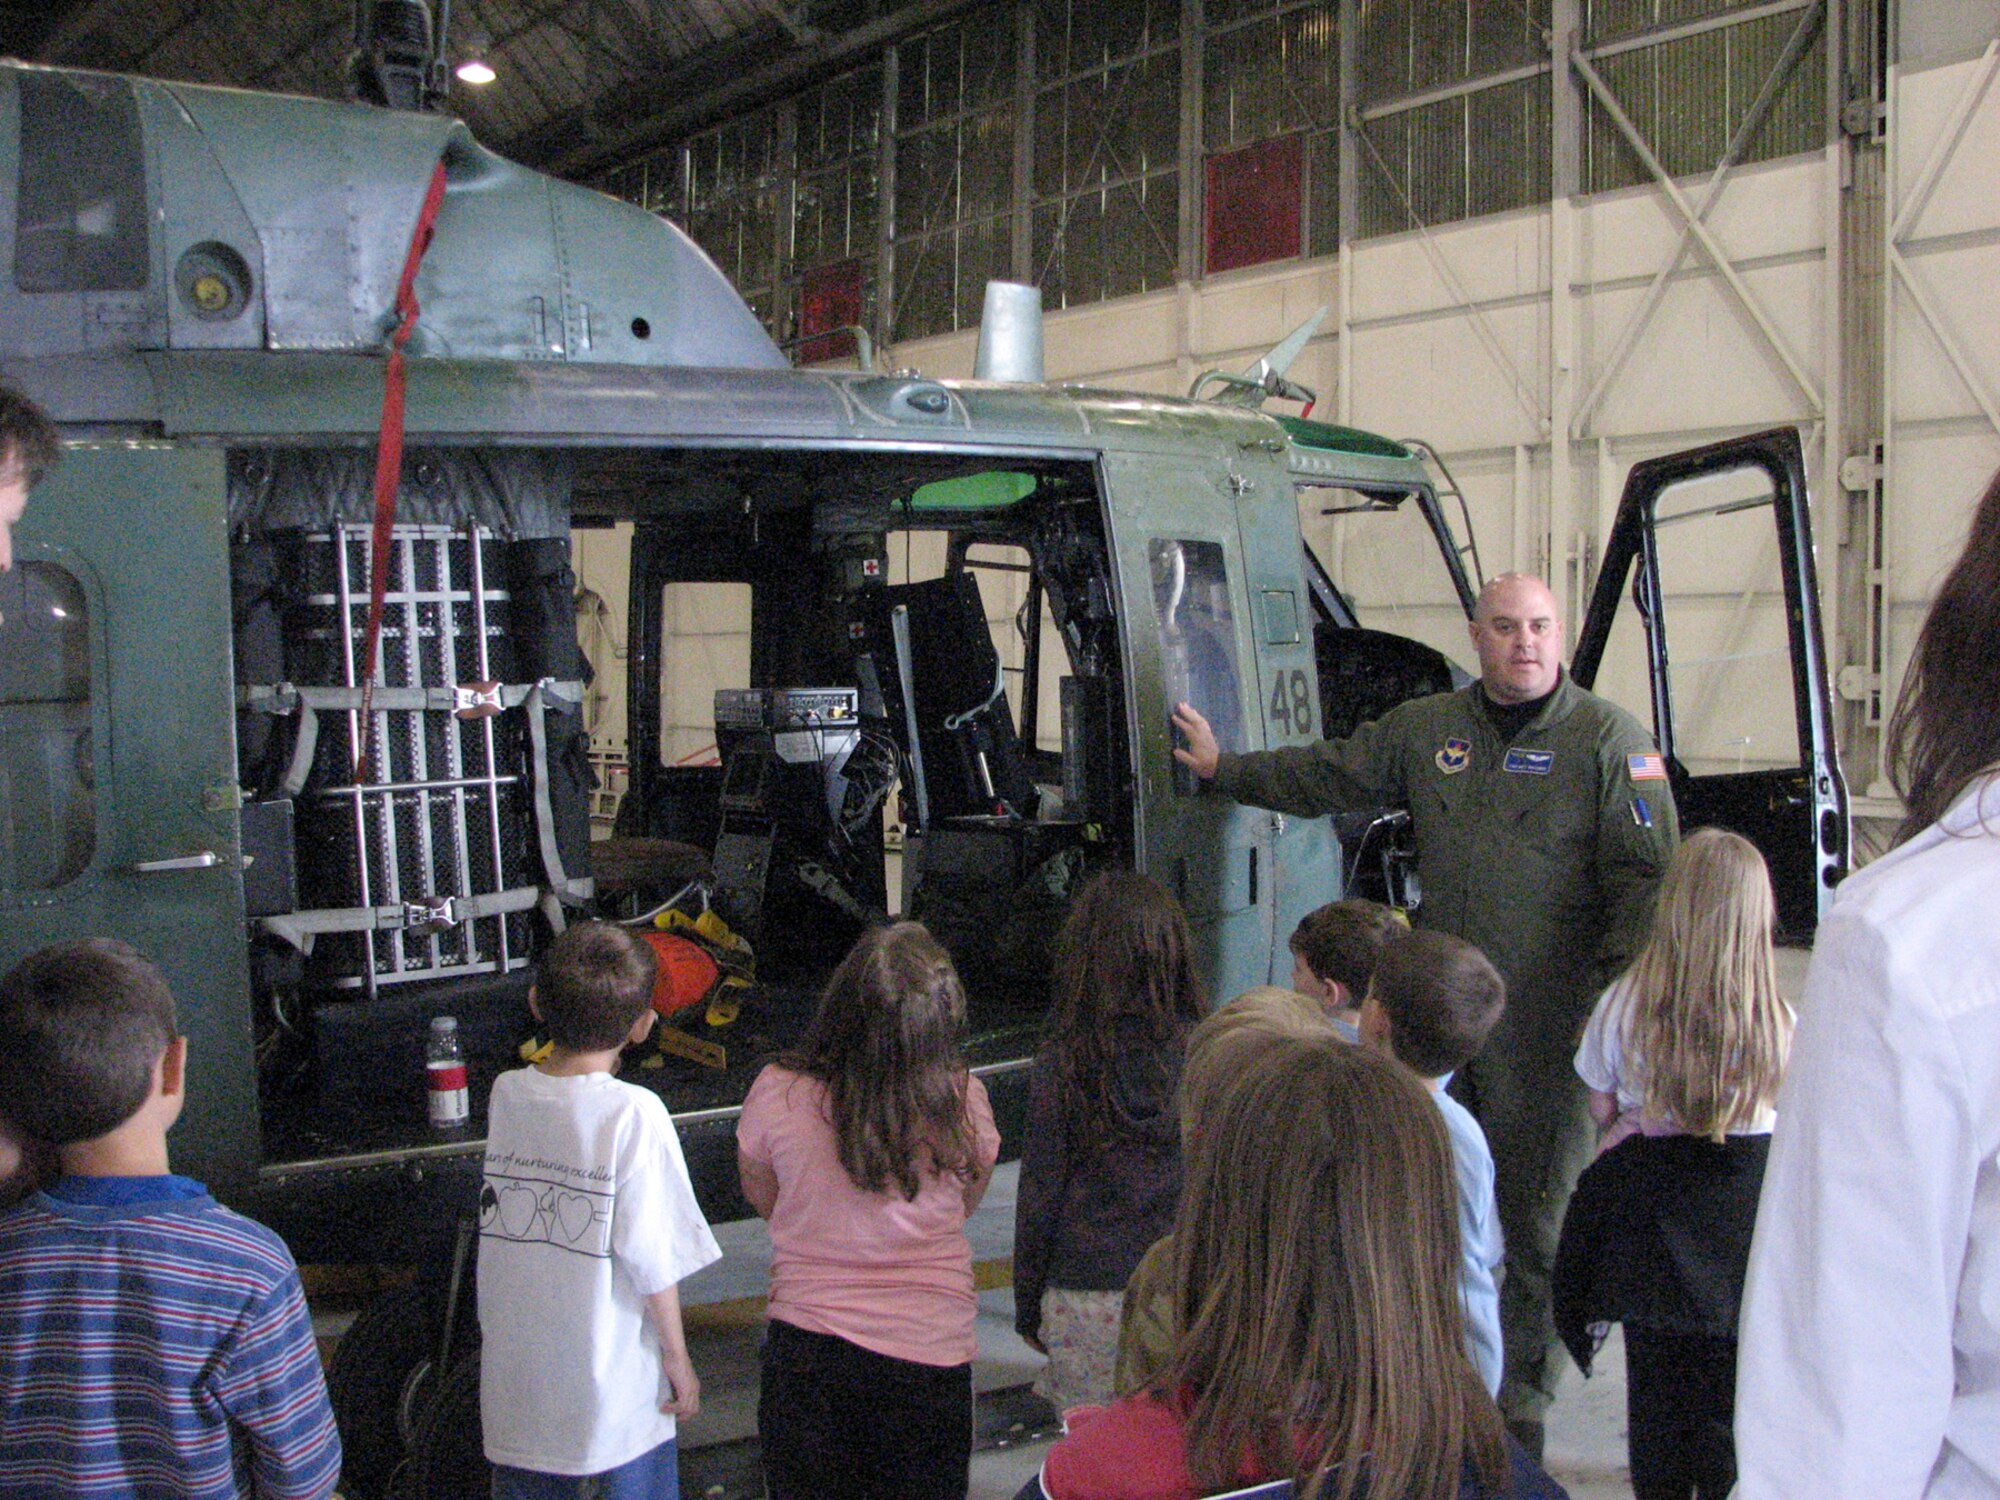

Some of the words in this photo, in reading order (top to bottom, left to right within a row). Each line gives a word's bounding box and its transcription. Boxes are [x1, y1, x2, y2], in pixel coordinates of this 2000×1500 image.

[1270, 669, 1312, 736] 48
[503, 1149, 516, 1173] of
[515, 1156, 570, 1183] nurturing
